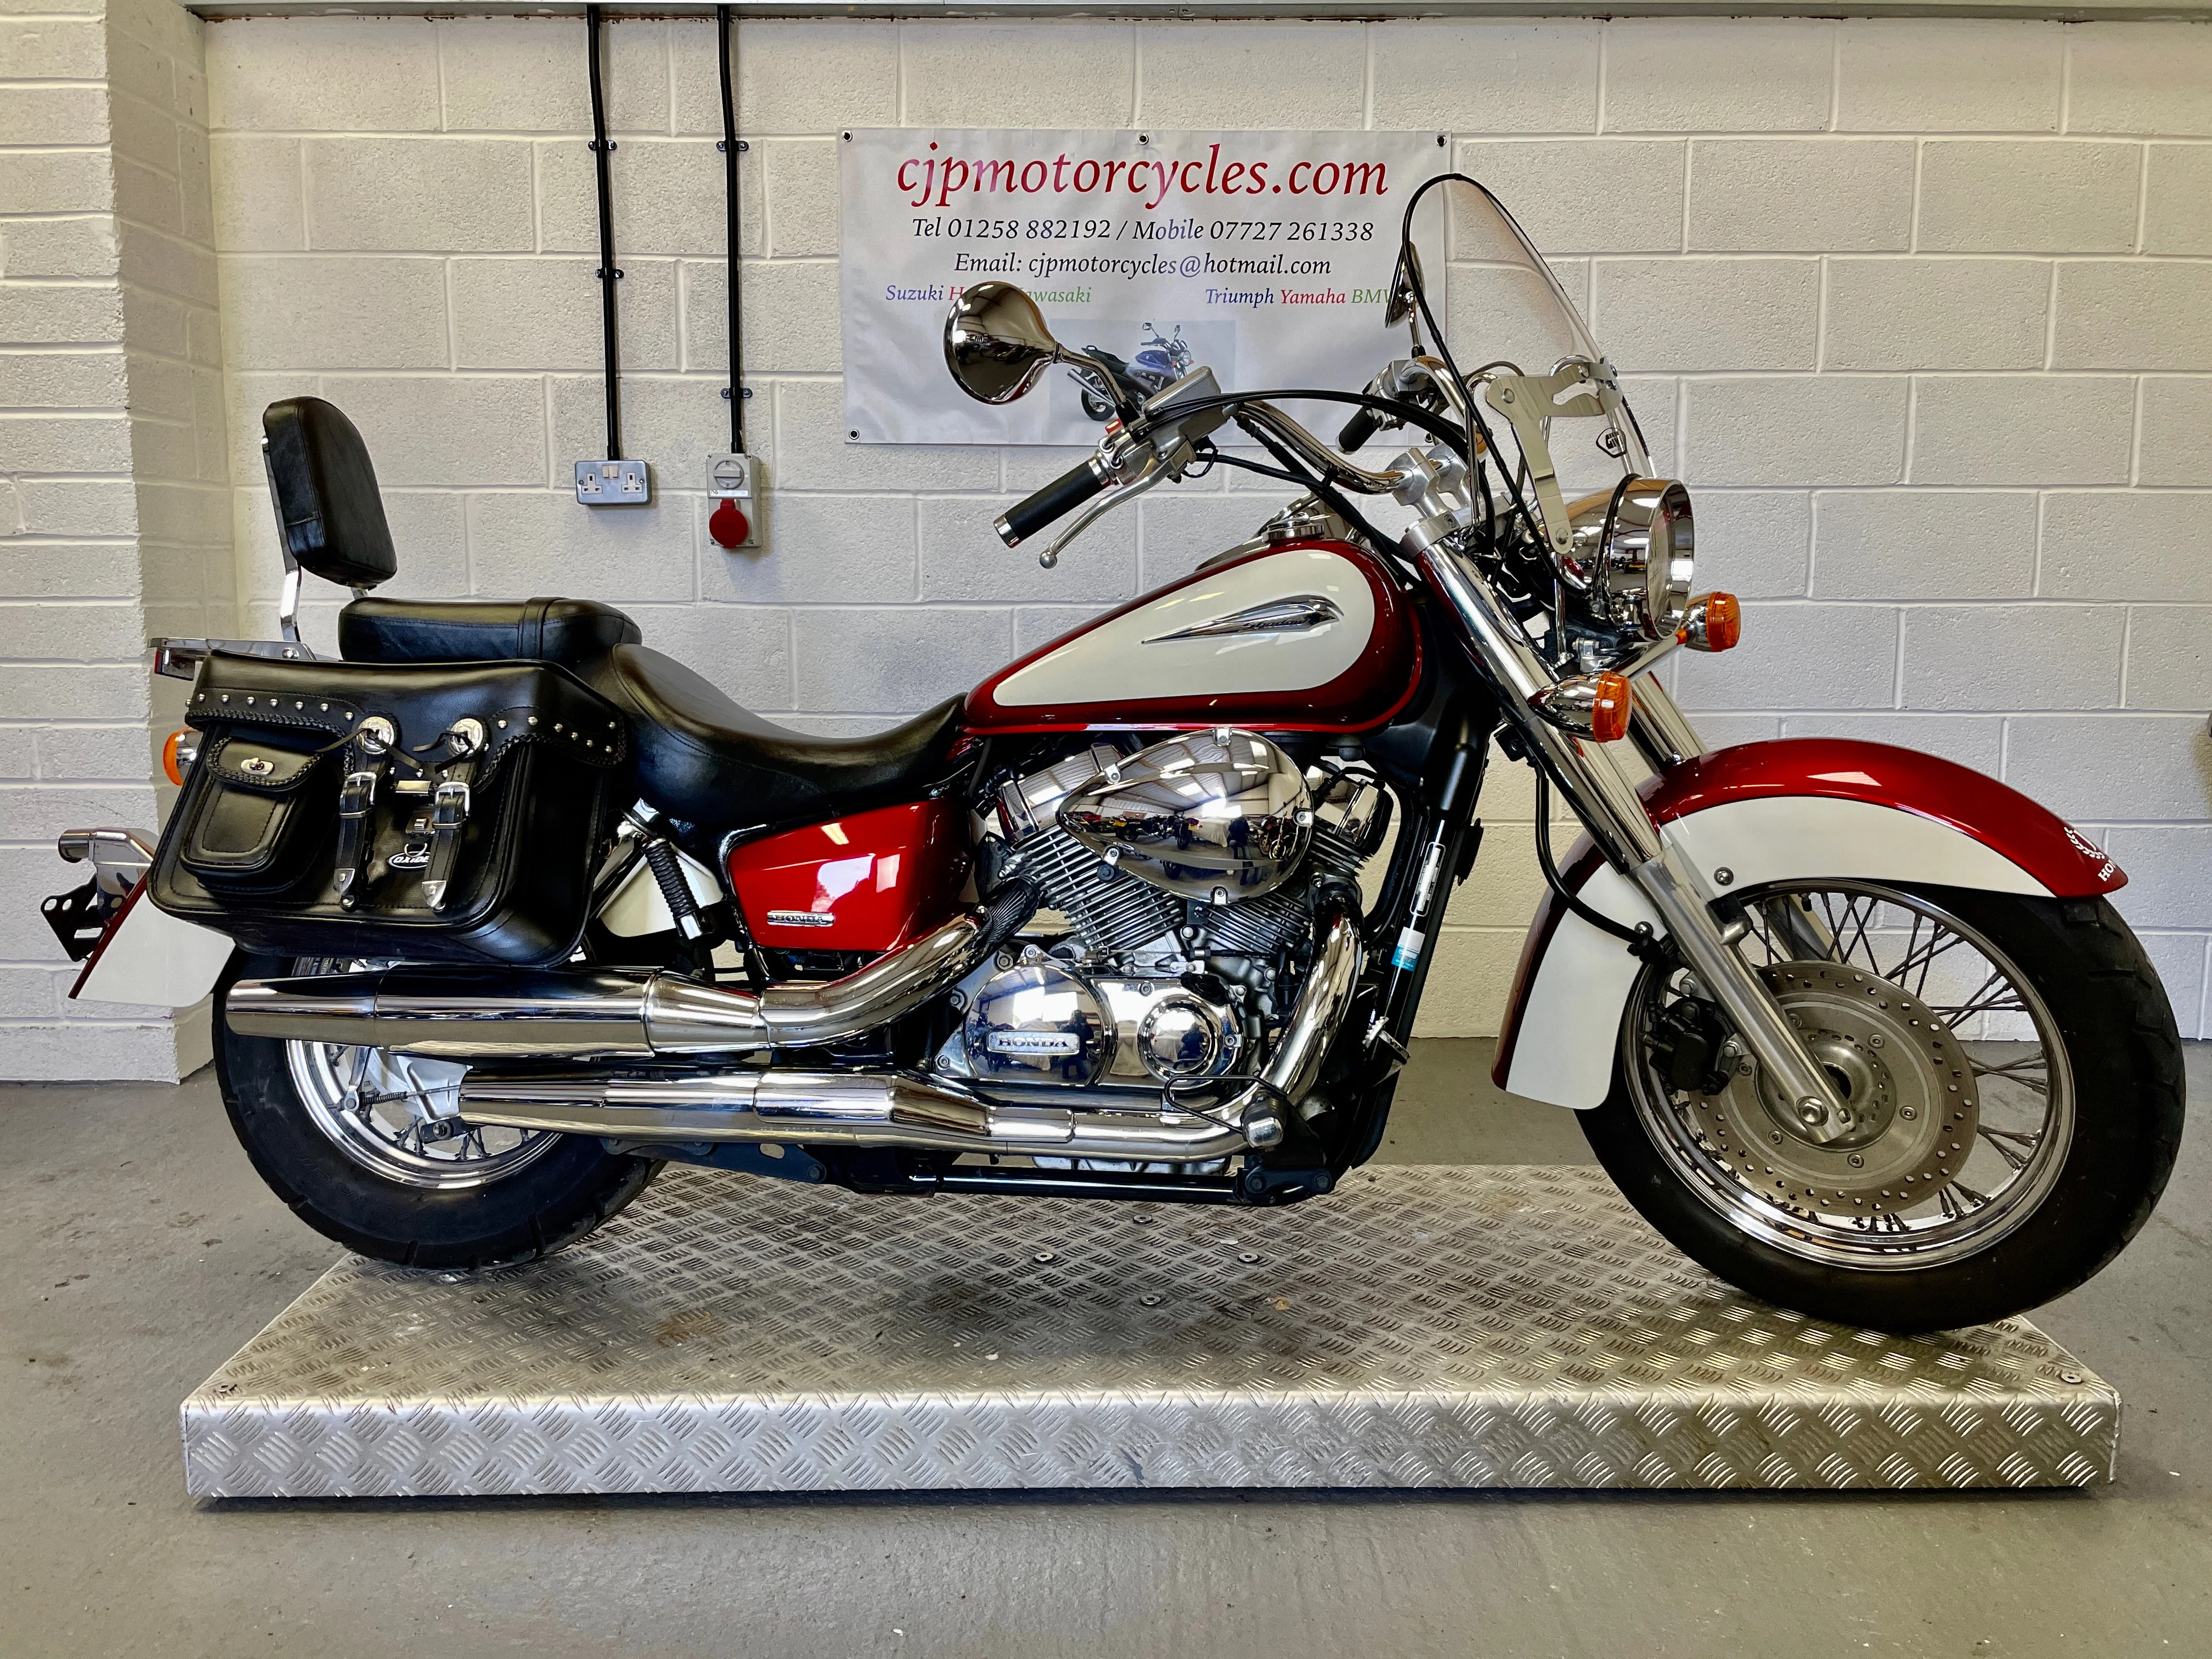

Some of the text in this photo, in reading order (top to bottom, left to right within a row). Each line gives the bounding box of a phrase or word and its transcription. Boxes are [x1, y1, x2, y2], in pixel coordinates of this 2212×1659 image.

[898, 142, 1389, 210] cjpmotorcycles.com
[913, 217, 1374, 242] Tel 01258 882192 / Mobile 07727 261338
[954, 252, 1332, 280] Email: cjpmotorcycles@hotmail.com
[886, 285, 944, 301] Suzuki
[1020, 286, 1092, 303] wasaki
[1206, 288, 1274, 309] Triumph
[1281, 288, 1346, 304] Yamaha
[774, 915, 825, 924] HONDA
[997, 1037, 1069, 1047] HONDA
